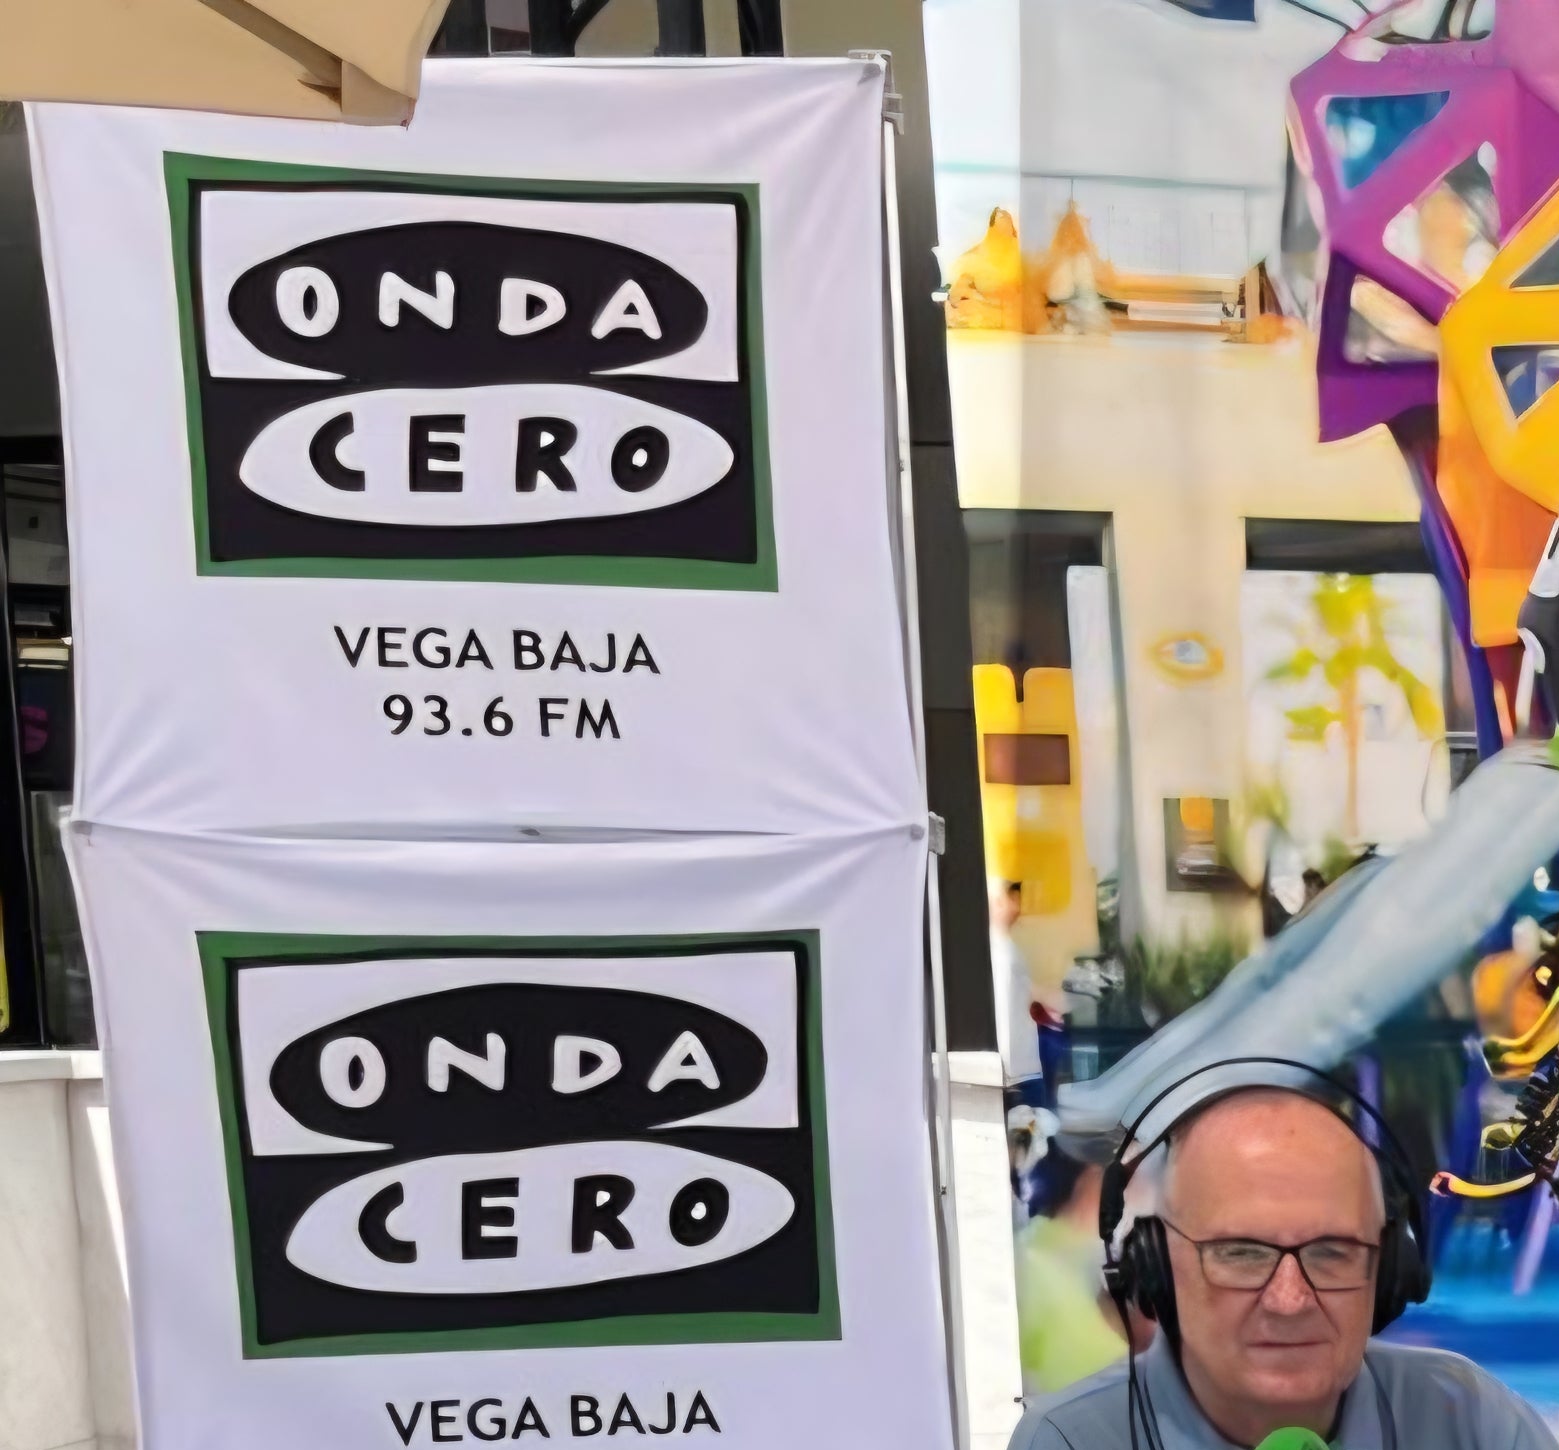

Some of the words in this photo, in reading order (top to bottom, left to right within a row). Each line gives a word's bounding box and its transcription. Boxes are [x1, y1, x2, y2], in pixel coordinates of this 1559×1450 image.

[276, 267, 662, 339] ONDA
[309, 412, 669, 493] CERO
[334, 626, 493, 670] VEGA
[513, 630, 660, 675] BAJA
[383, 695, 514, 737] 93.6
[539, 698, 620, 739] FM
[320, 1031, 721, 1109] ONDA
[358, 1174, 729, 1263] CERO
[386, 1396, 550, 1447] VEGA
[570, 1390, 721, 1437] BAJA
